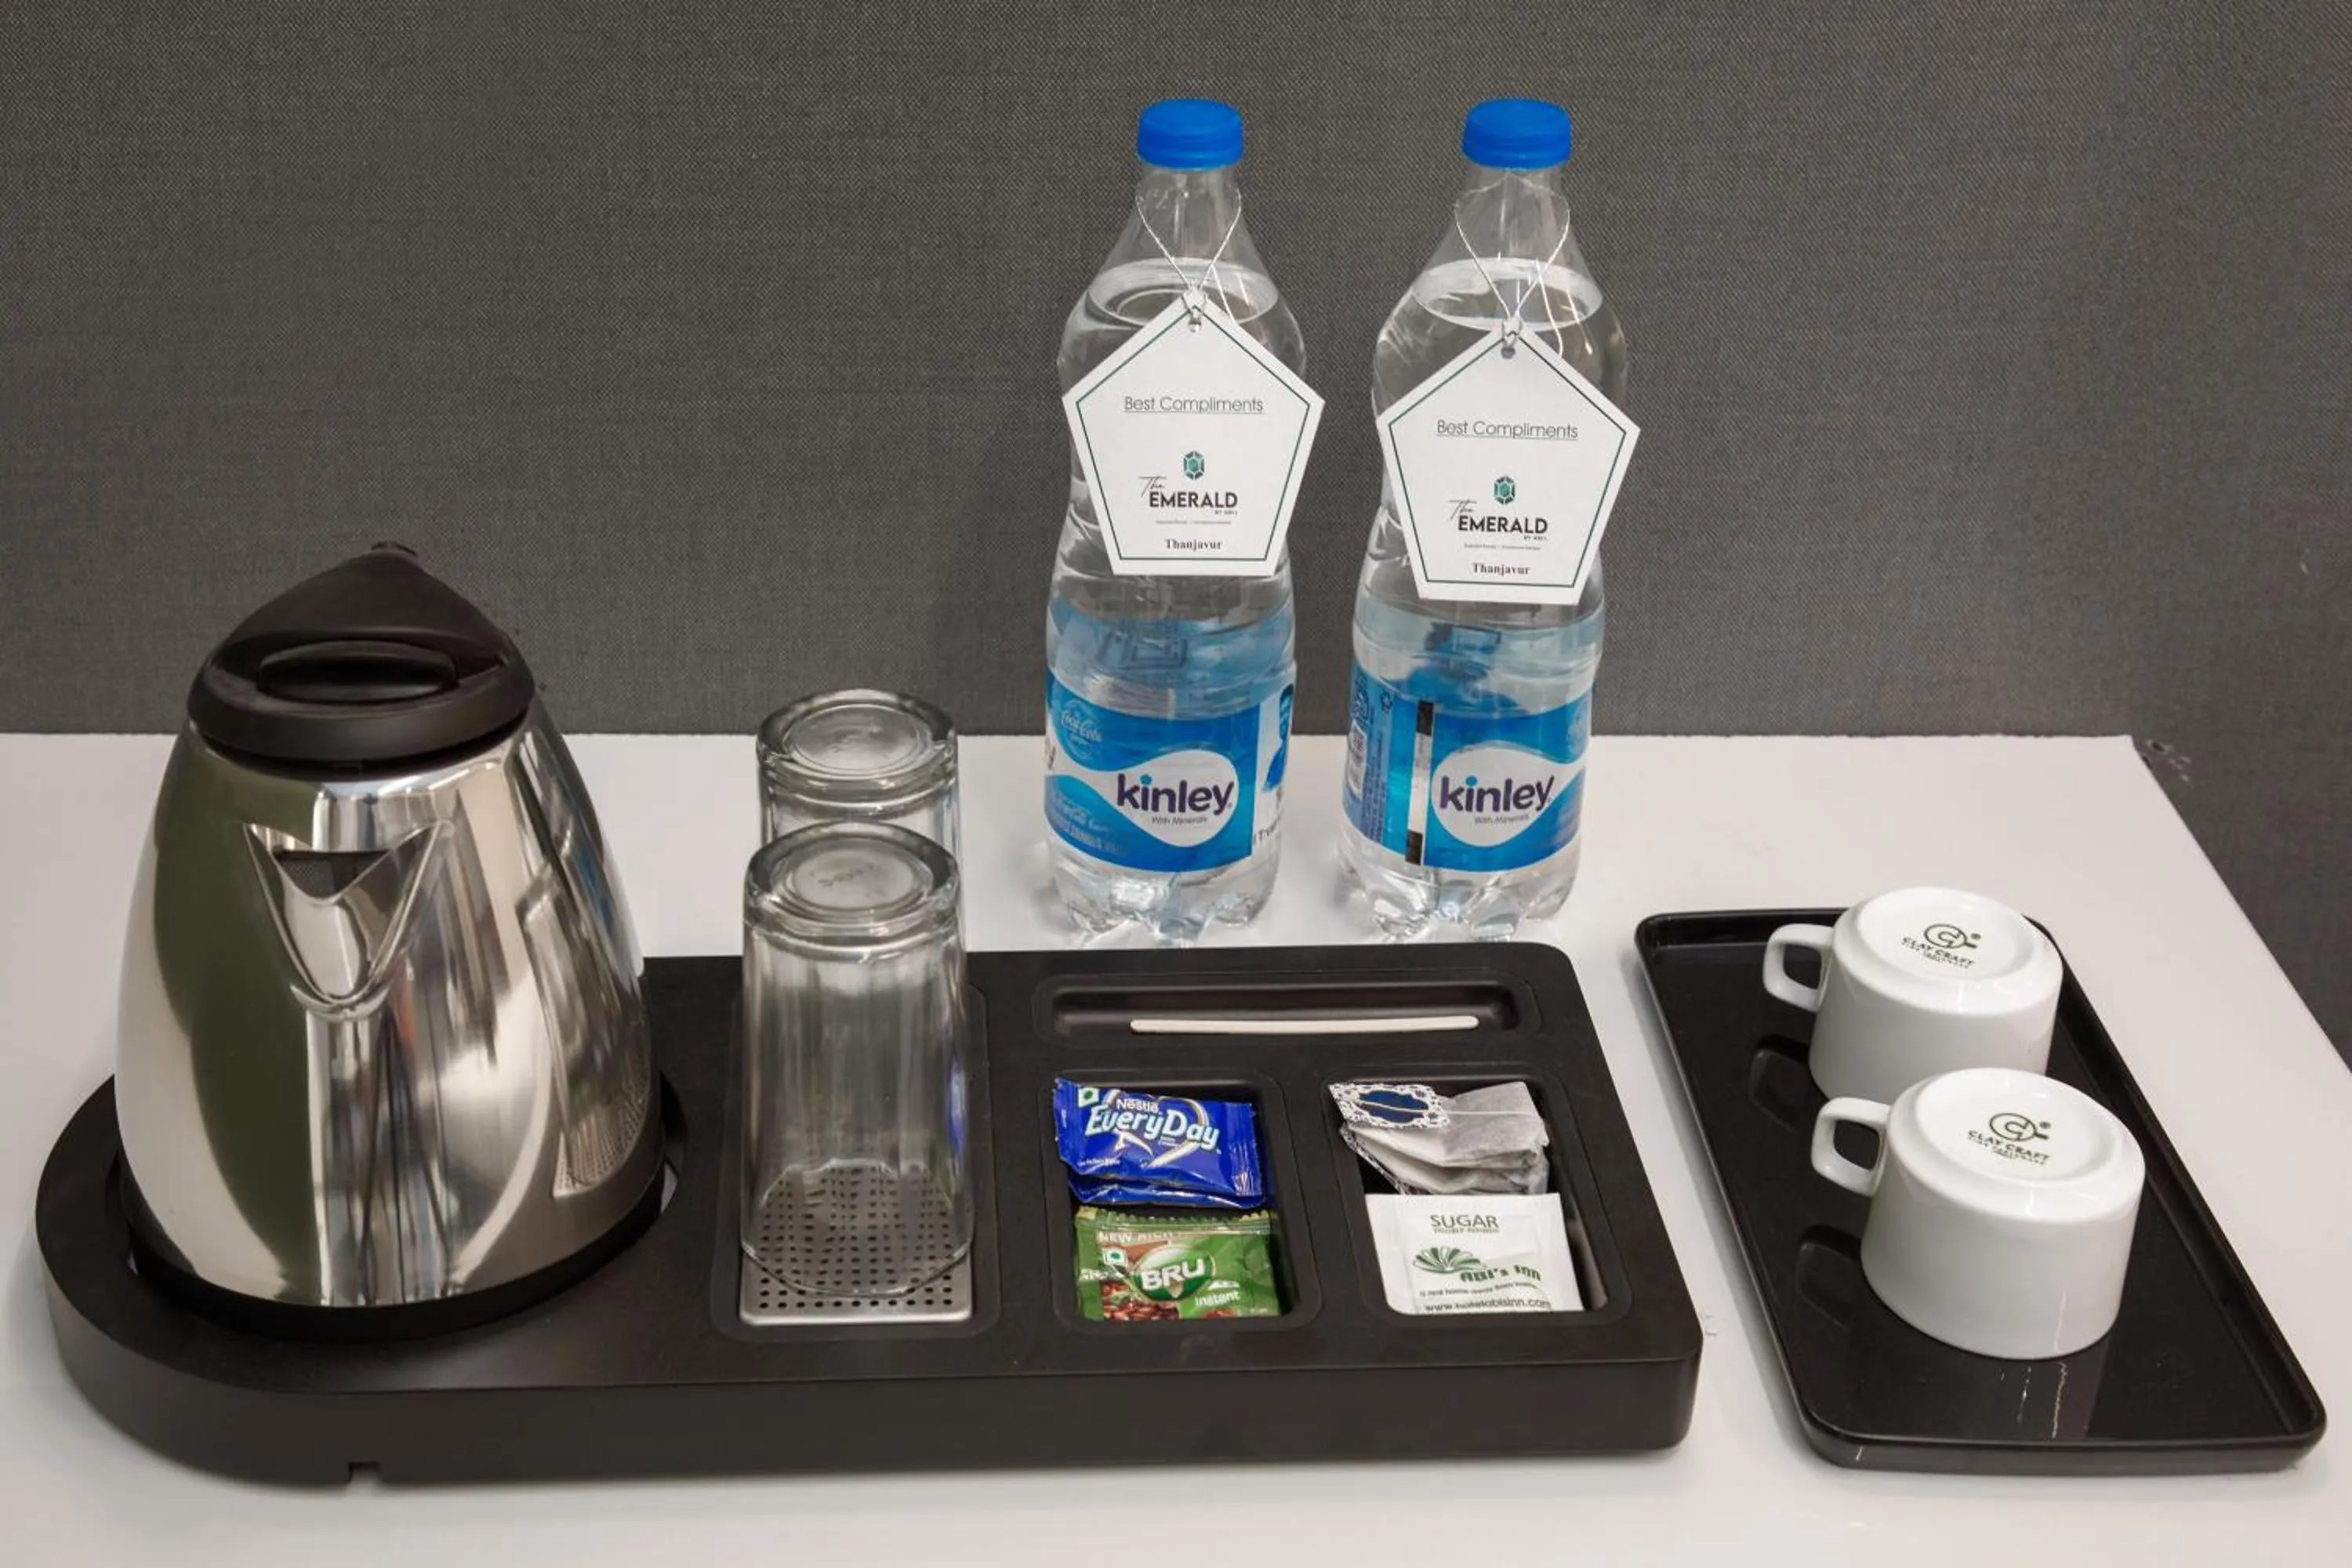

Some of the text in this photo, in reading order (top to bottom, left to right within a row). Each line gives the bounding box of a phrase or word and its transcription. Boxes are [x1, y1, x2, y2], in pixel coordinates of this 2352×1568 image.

[1124, 396, 1264, 413] Best Compliments
[1437, 419, 1578, 439] Best Compliments
[1139, 476, 1167, 497] The
[1149, 492, 1238, 508] EMERALD
[1448, 499, 1477, 520] The
[1458, 515, 1548, 534] EMERALD
[1166, 539, 1221, 551] Thanjavur
[1472, 563, 1530, 575] Thanjavur
[1116, 773, 1234, 815] kinley
[1439, 775, 1555, 812] kinley
[1901, 937, 1936, 953] CLAY
[1935, 949, 1975, 966] CRAFT
[1085, 1105, 1220, 1151] EveryDay
[1968, 1130, 2005, 1146] CLAY
[2005, 1144, 2051, 1162] CRAFT
[1430, 1214, 1499, 1229] SUGAR
[1141, 1258, 1205, 1290] BRU
